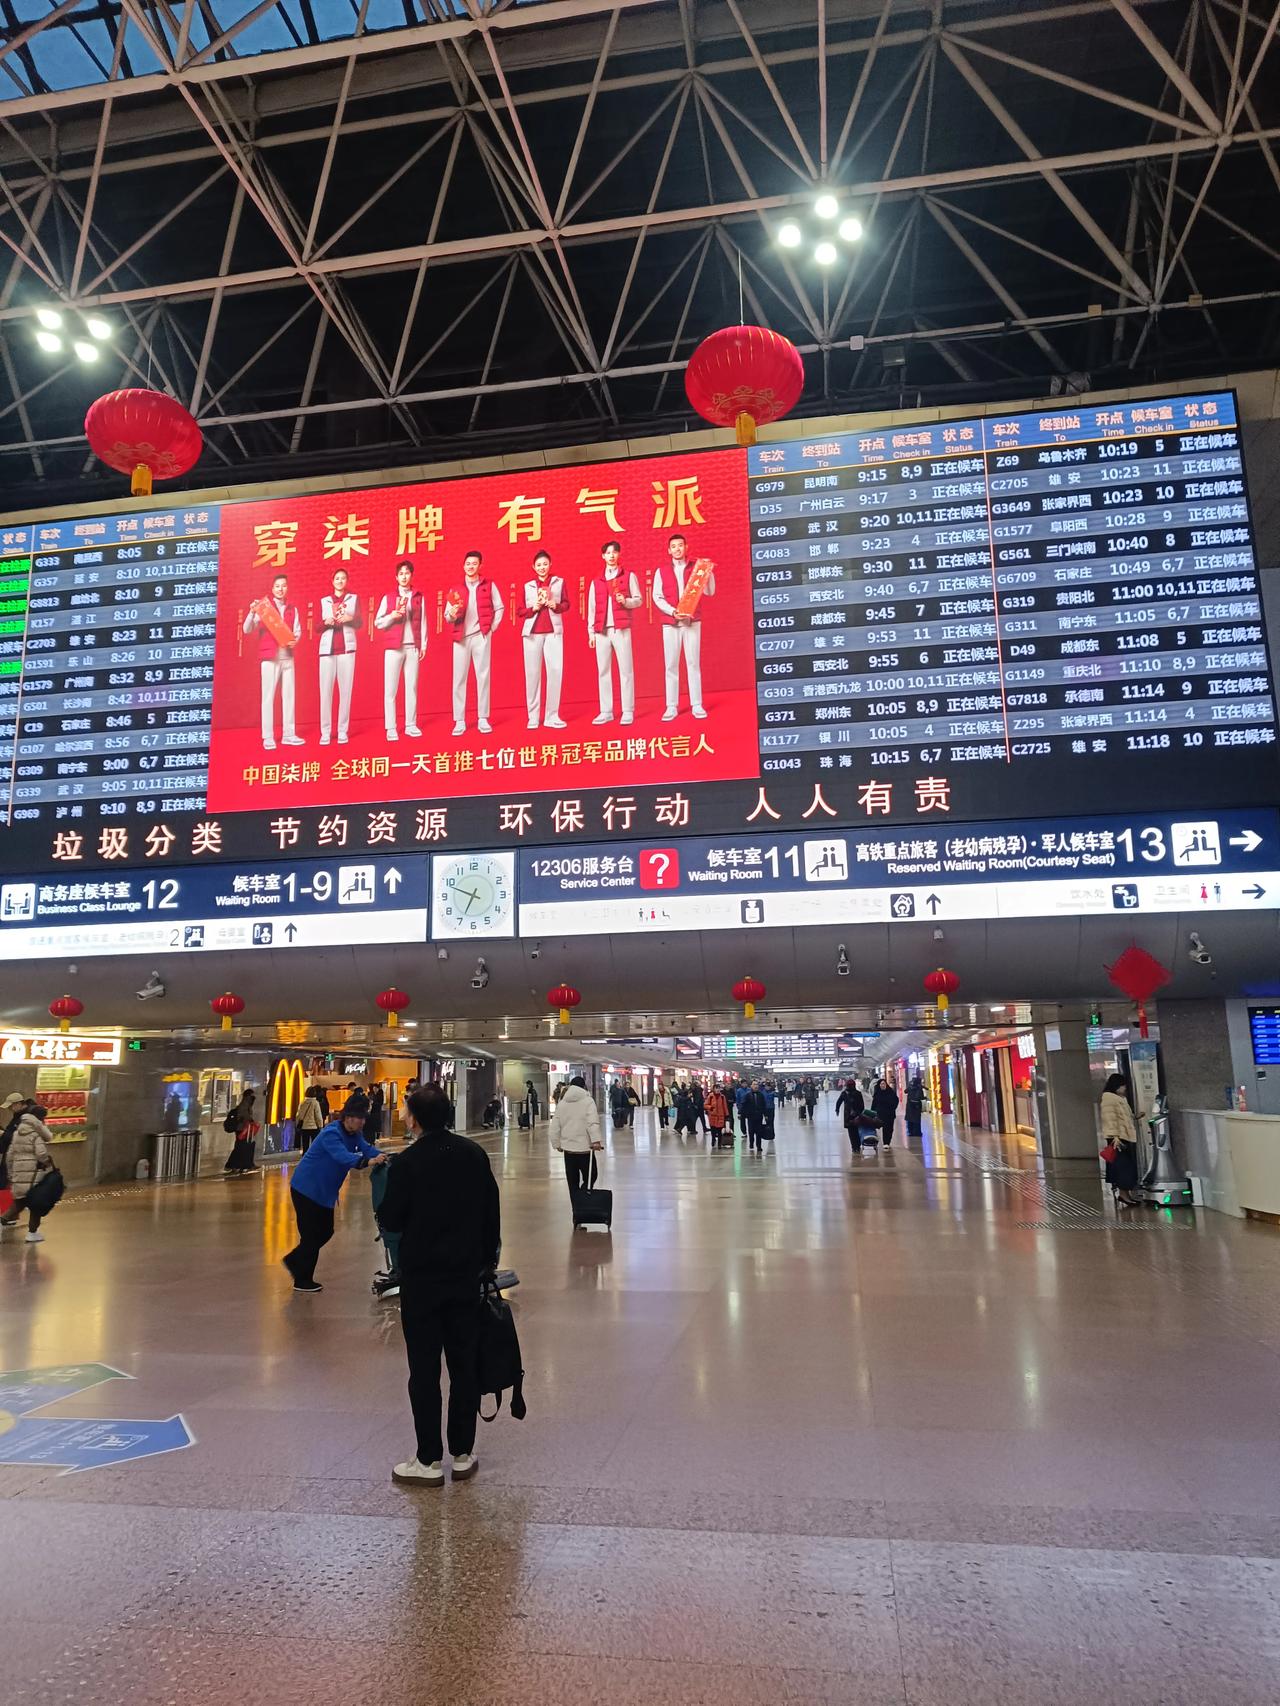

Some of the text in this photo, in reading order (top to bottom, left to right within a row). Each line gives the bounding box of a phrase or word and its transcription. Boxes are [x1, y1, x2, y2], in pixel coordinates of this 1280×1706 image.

[992, 402, 1217, 436] 车次 终到站 开点 候车室 状态
[759, 428, 973, 462] 车次 终到站 开点 候车室 状态
[997, 433, 1237, 467] Z69 乌鲁木齐 10:19 5 正在候车
[756, 458, 984, 492] G979 昆明南 9:15 8,9 正在候车
[992, 480, 1243, 514] G3649 张家界西 10:23 10 正在候车
[252, 476, 707, 568] 穿柒牌 有气派
[758, 526, 787, 537] G689
[861, 515, 889, 528] 9:20
[897, 511, 933, 525] 10,11
[934, 505, 988, 522] 正在候车
[999, 528, 1249, 561] G561 三门峡南 10:40 8 正在候车
[756, 552, 991, 582] G7813 邯郸东 9:30 11 正在候车
[1003, 577, 1255, 608] G319 贵阳北 11:00 10,11 正在候车
[758, 599, 994, 628] G1015 成都东 9:45 7 正在候车
[111, 652, 135, 662] 8:26
[148, 650, 162, 660] 10
[170, 645, 214, 660] 正在候车
[1010, 627, 1261, 656] D49 成都东 11:08 5 正在候车
[763, 647, 998, 674] G365 西安北 9:55 6 正在候车
[764, 671, 1000, 697] G303 香港西九龙 10:00 10,11 正在候车
[1007, 677, 1268, 705] G7818 承德南 11:14 9 正在候车
[106, 716, 132, 727] 8:46
[147, 714, 155, 724] 5
[166, 709, 211, 724] 正在候车
[765, 695, 1002, 722] G371 郑州东 10:05 8,9 正在候车
[1012, 742, 1051, 755] C2725
[1127, 735, 1170, 750] 11:18
[1183, 733, 1203, 746] 10
[1214, 728, 1275, 746] 正在候车
[243, 733, 715, 786] 中国柒牌 全球同一天首推七位世界冠军品牌代言人
[764, 759, 801, 770] G1043
[871, 751, 910, 764] 10:15
[920, 749, 942, 762] 6,7
[951, 745, 1006, 761] 正在候车
[102, 781, 126, 792] 9:05
[132, 779, 161, 790] 10,11
[162, 776, 207, 789] 正在候车
[52, 776, 950, 860] 垃圾分类 节约资源 环保行动 人人有责
[1117, 827, 1166, 862] 13
[457, 867, 463, 875] 11
[531, 856, 634, 877] 12306服务台
[688, 869, 762, 882] Waiting Room
[707, 845, 799, 878] 候车室 11
[888, 852, 1115, 874] Reserved Waiting Room(Courtesy Seat)
[39, 879, 179, 909] 商务座候车室 12
[232, 871, 332, 902] 候车室 1-9
[446, 878, 455, 886] 10
[560, 875, 635, 889] Service Center
[38, 901, 141, 914] Business Class Lounge
[215, 894, 280, 906] Waiting Room
